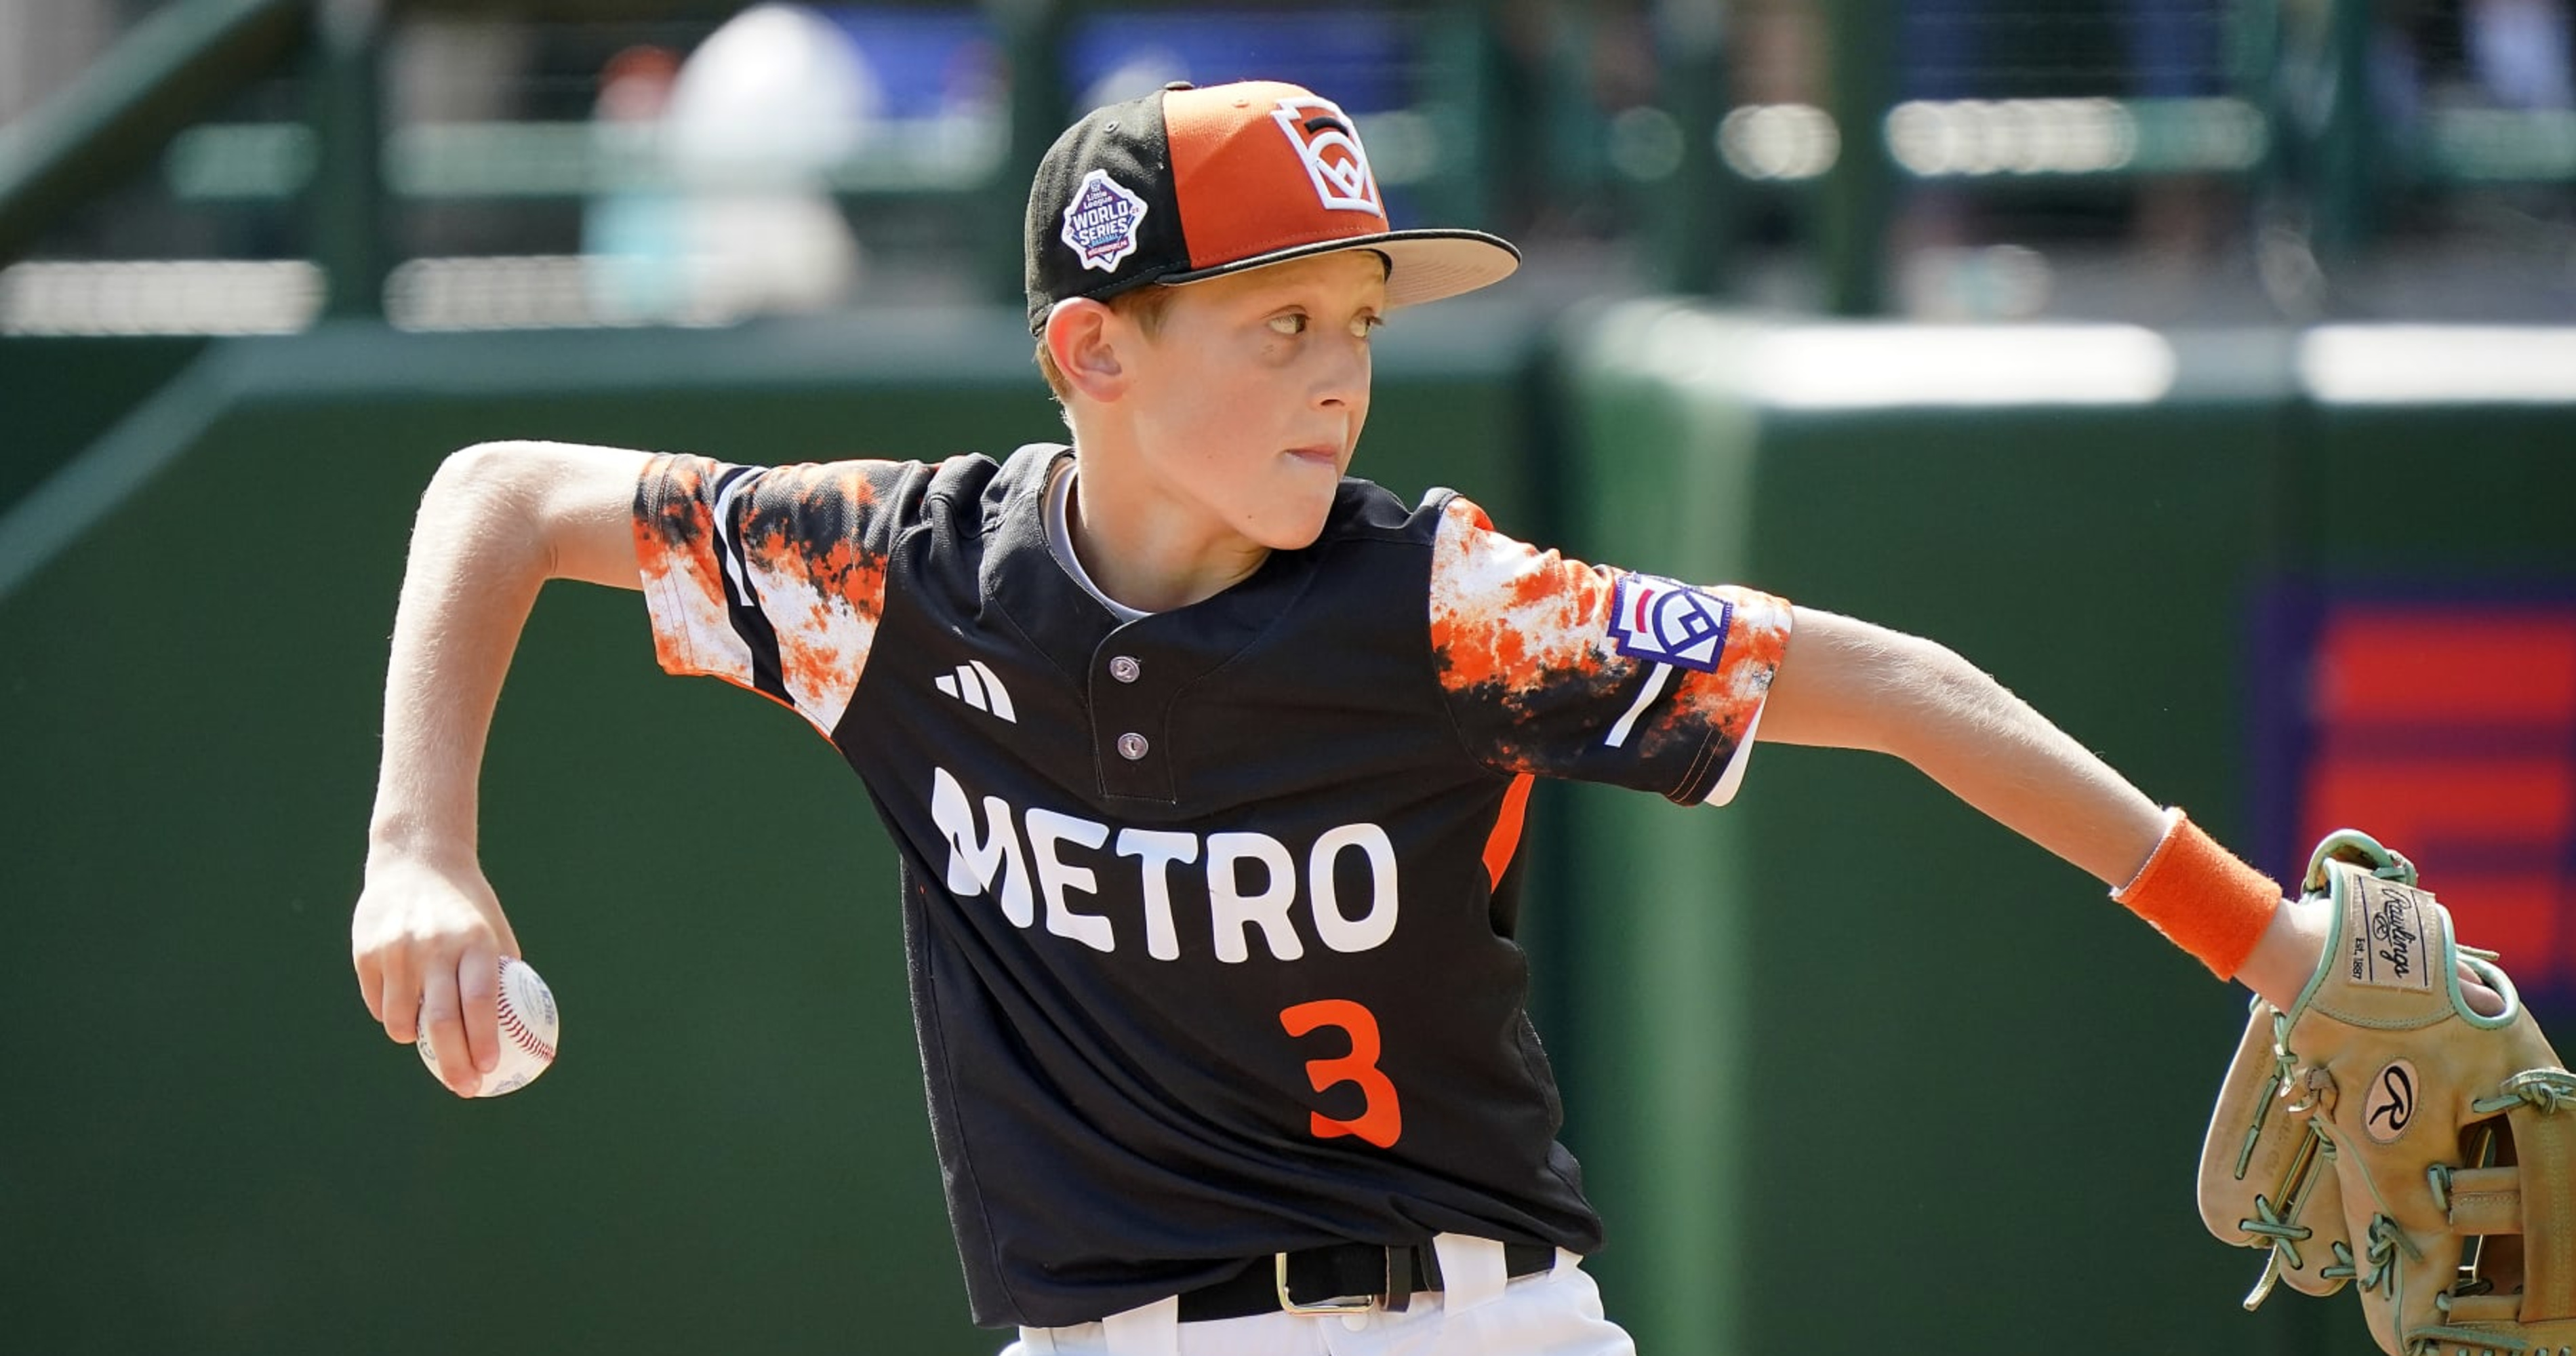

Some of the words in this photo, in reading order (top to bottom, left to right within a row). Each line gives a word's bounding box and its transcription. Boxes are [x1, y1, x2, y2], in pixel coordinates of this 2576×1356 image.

[1072, 200, 1129, 231] WORLD
[1079, 217, 1129, 246] SERIES
[931, 767, 1398, 963] METRO
[2380, 888, 2417, 978] Rawlings
[2352, 957, 2364, 980] 1887
[1279, 999, 1402, 1148] 3
